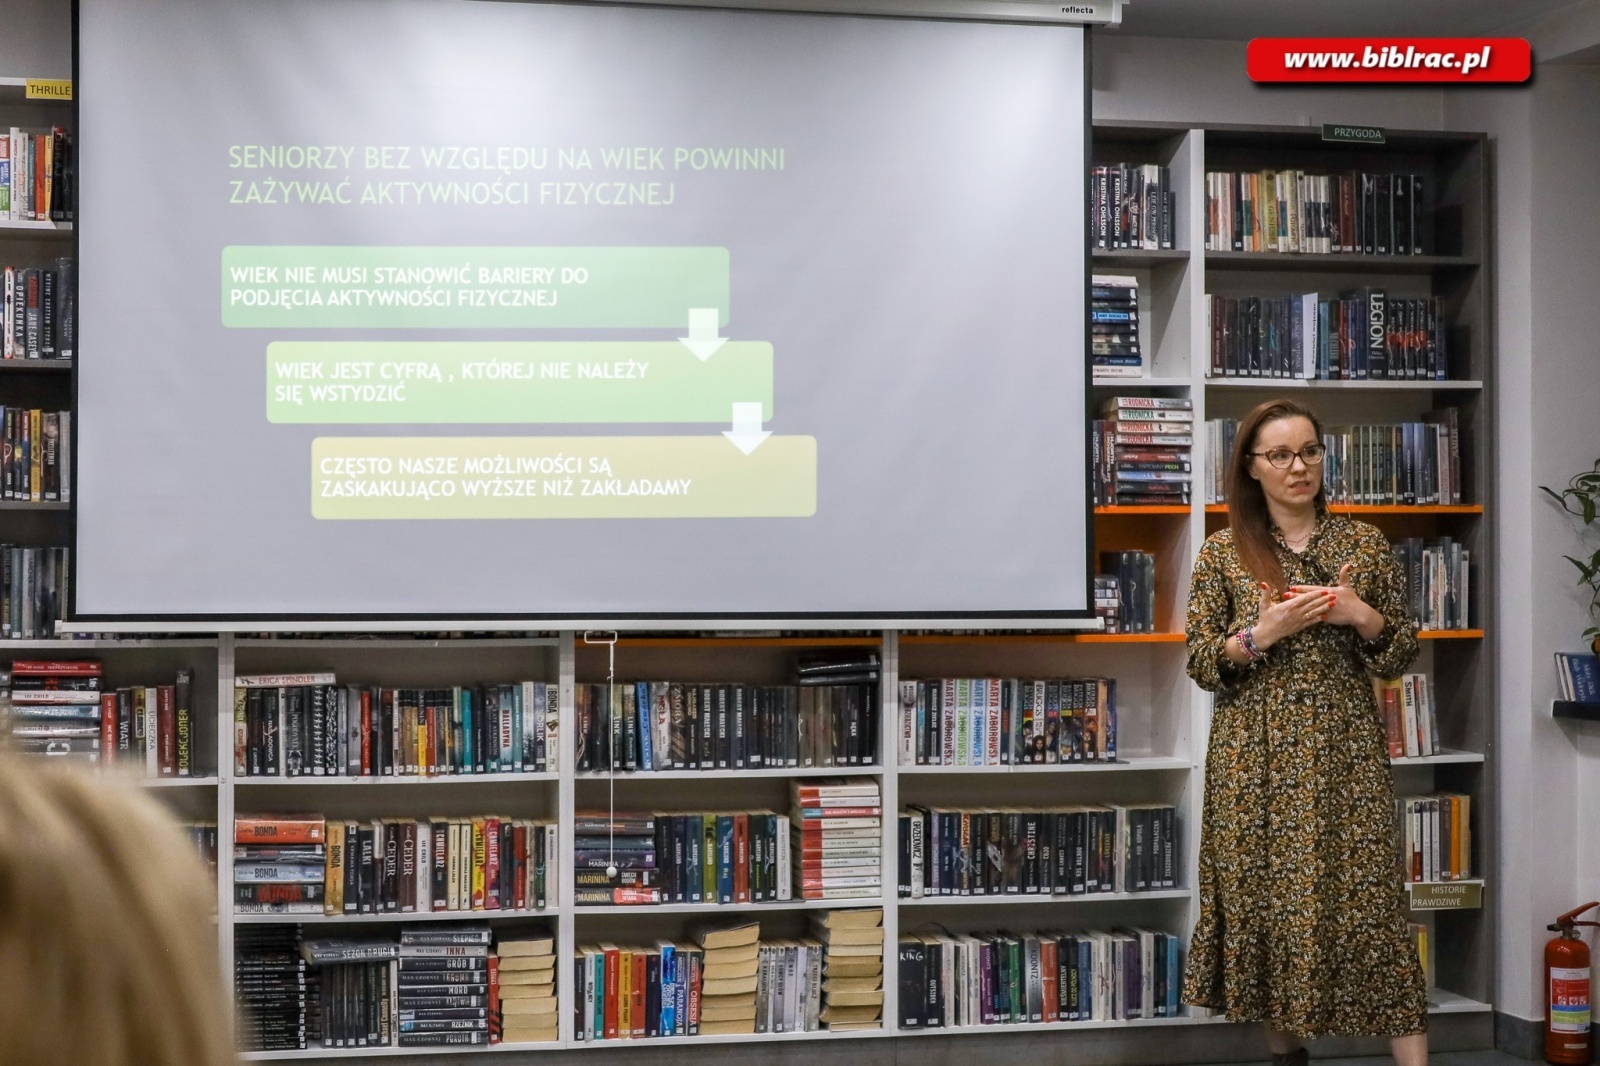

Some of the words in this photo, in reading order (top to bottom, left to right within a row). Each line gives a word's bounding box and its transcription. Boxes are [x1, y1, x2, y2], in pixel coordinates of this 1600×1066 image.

[1062, 6, 1094, 14] reflecta
[1334, 127, 1382, 140] PRZYGODA
[229, 145, 355, 169] SENIORZY
[364, 146, 410, 169] BEZ
[421, 146, 548, 175] WZGLĘDU
[558, 147, 593, 170] NA
[600, 147, 665, 170] WIEK
[675, 147, 785, 171] POWINNI
[229, 176, 352, 204] ZAŻYWAĆ
[360, 176, 528, 205] AKTYWNOŚCI
[540, 182, 675, 205] FIZYCZNEJ
[230, 265, 278, 284] WIEK
[286, 265, 316, 284] NIE
[322, 265, 367, 284] MUSI
[375, 263, 471, 284] STANOWIĆ
[479, 267, 555, 284] BARIERY
[561, 267, 589, 284] DO
[230, 288, 323, 309] PODJĘCIA
[327, 286, 450, 306] AKTYWNOŚCI
[458, 289, 558, 307] FIZYCZNEJ
[16, 285, 24, 337] OPIEKUNKA
[1370, 293, 1384, 348] LEGION
[275, 362, 324, 379] WIEK
[330, 362, 374, 379] JEST
[380, 362, 443, 383] CYFRĄ
[462, 358, 534, 379] KTÓREJ
[541, 362, 571, 379] NIE
[578, 359, 649, 379] NALEŻY
[275, 384, 303, 405] SIĘ
[309, 381, 406, 402] WSTYDZIĆ
[320, 457, 392, 478] CZĘSTO
[399, 457, 458, 475] NASZE
[463, 453, 582, 475] MOŻLIWOŚCI
[589, 457, 613, 477] SĄ
[320, 480, 455, 500] ZASKAKUJĄCO
[461, 476, 537, 496] WYŻSZE
[543, 476, 574, 496] NIŻ
[258, 675, 280, 686] ERICA
[281, 674, 316, 684] SPINDLER
[547, 690, 558, 714] BONDA
[945, 679, 953, 707] MARTA
[958, 679, 967, 707] MARTA
[974, 679, 983, 707] MARTA
[990, 679, 998, 707] MARTA
[1035, 684, 1043, 716] BRIGGS
[658, 695, 666, 725] MGŁA
[674, 688, 682, 724] ZMORA
[120, 721, 128, 750] WIATR
[148, 710, 156, 750] UCIECZKA
[502, 710, 510, 748] BALLADYNA
[254, 826, 277, 836] BONDA
[912, 821, 922, 858] GRZĘDOWICZ
[1027, 822, 1036, 860] CHRISTINE
[330, 845, 340, 868] BONDA
[362, 840, 371, 865] LALKI
[387, 840, 396, 877] CEDER
[403, 840, 414, 876] CEDER
[435, 833, 444, 868] CHMIELARZ
[474, 834, 484, 868] CHMIELARZ
[488, 832, 498, 866] CHMIELARZ
[254, 868, 278, 878] BONDA
[577, 876, 610, 884] MARININA
[578, 894, 611, 902] MARININA
[1412, 897, 1461, 907] PRAWDZIWE
[1431, 885, 1467, 895] HISTORIE
[342, 949, 366, 959] SEZON
[446, 947, 466, 955] INNA
[446, 958, 467, 968] GRÓB
[900, 952, 924, 962] KING
[448, 986, 468, 994] MORD
[676, 989, 684, 1027] PARANOJA
[451, 1020, 474, 1028] RZEŹNIK
